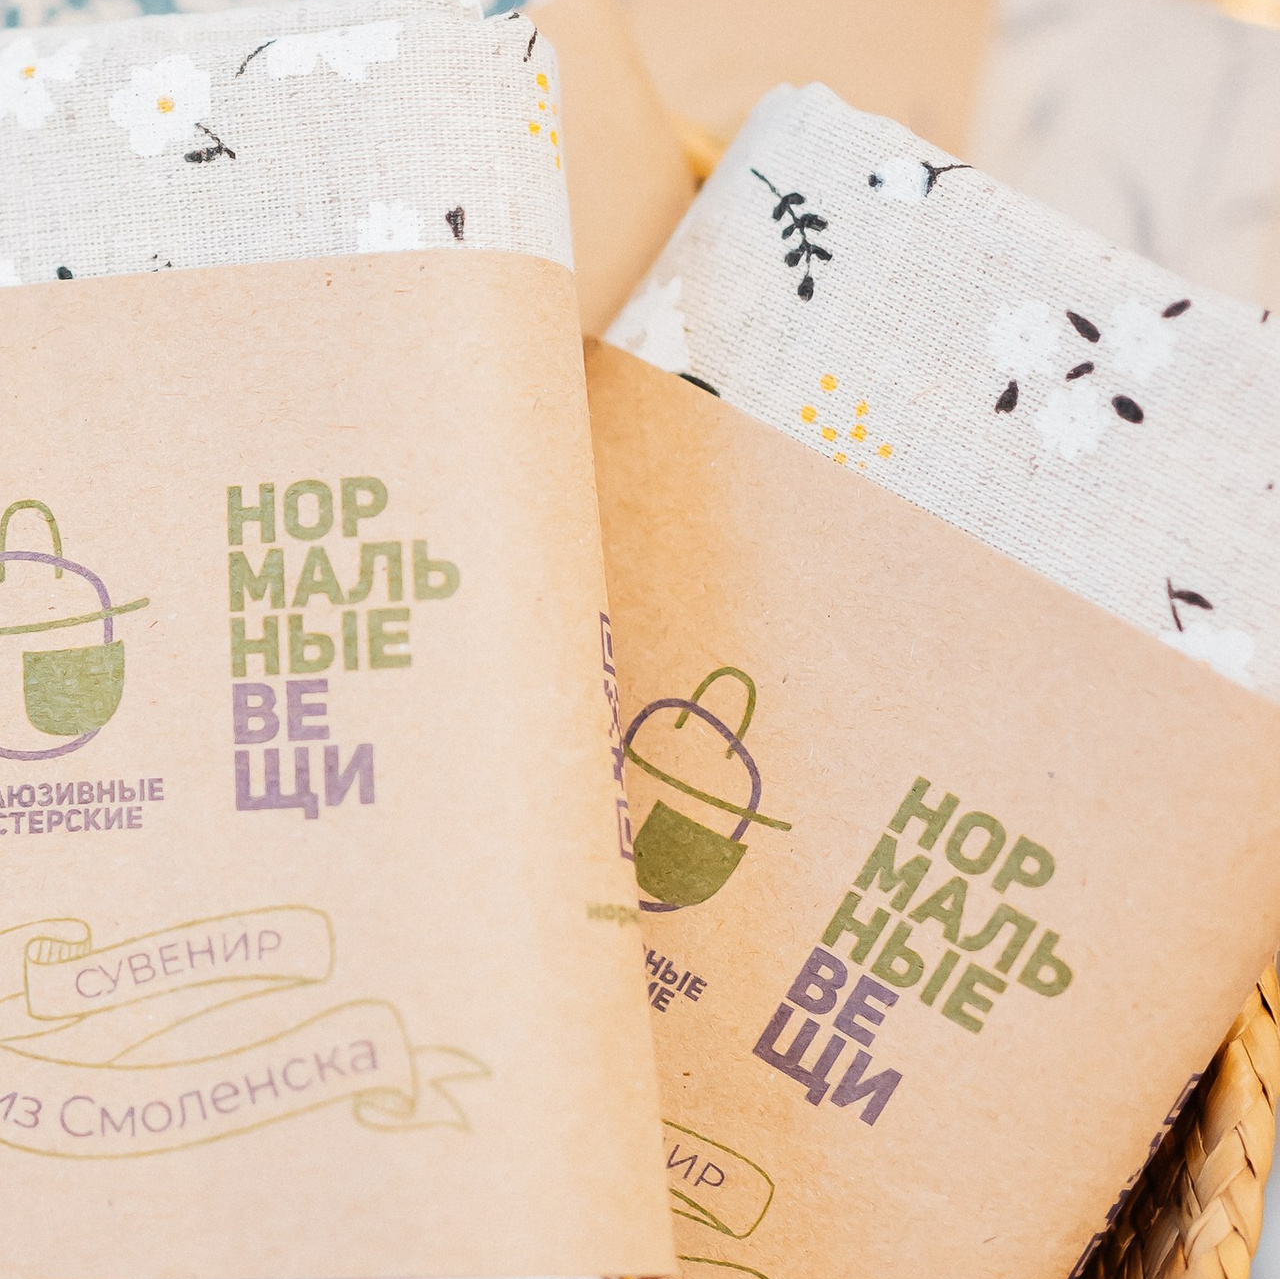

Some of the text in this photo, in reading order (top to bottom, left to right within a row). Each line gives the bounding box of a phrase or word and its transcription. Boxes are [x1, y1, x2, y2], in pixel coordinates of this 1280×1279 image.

[227, 475, 389, 546] НОР
[227, 538, 461, 612] МАЛЬ
[230, 606, 412, 678] НЫЕ
[232, 677, 330, 744] ВЕ
[234, 743, 376, 820] ЩИ
[886, 775, 1056, 895] НОР
[852, 833, 1074, 999] МАЛЬ
[75, 929, 282, 999] СУВЕНИР
[644, 949, 708, 1002] НЫЕ
[786, 946, 901, 1048] ВЕ
[821, 891, 1010, 1036] НЫЕ
[59, 1038, 379, 1138] Смоленска
[752, 1002, 904, 1127] ЩИ
[665, 1144, 726, 1188] ИР
